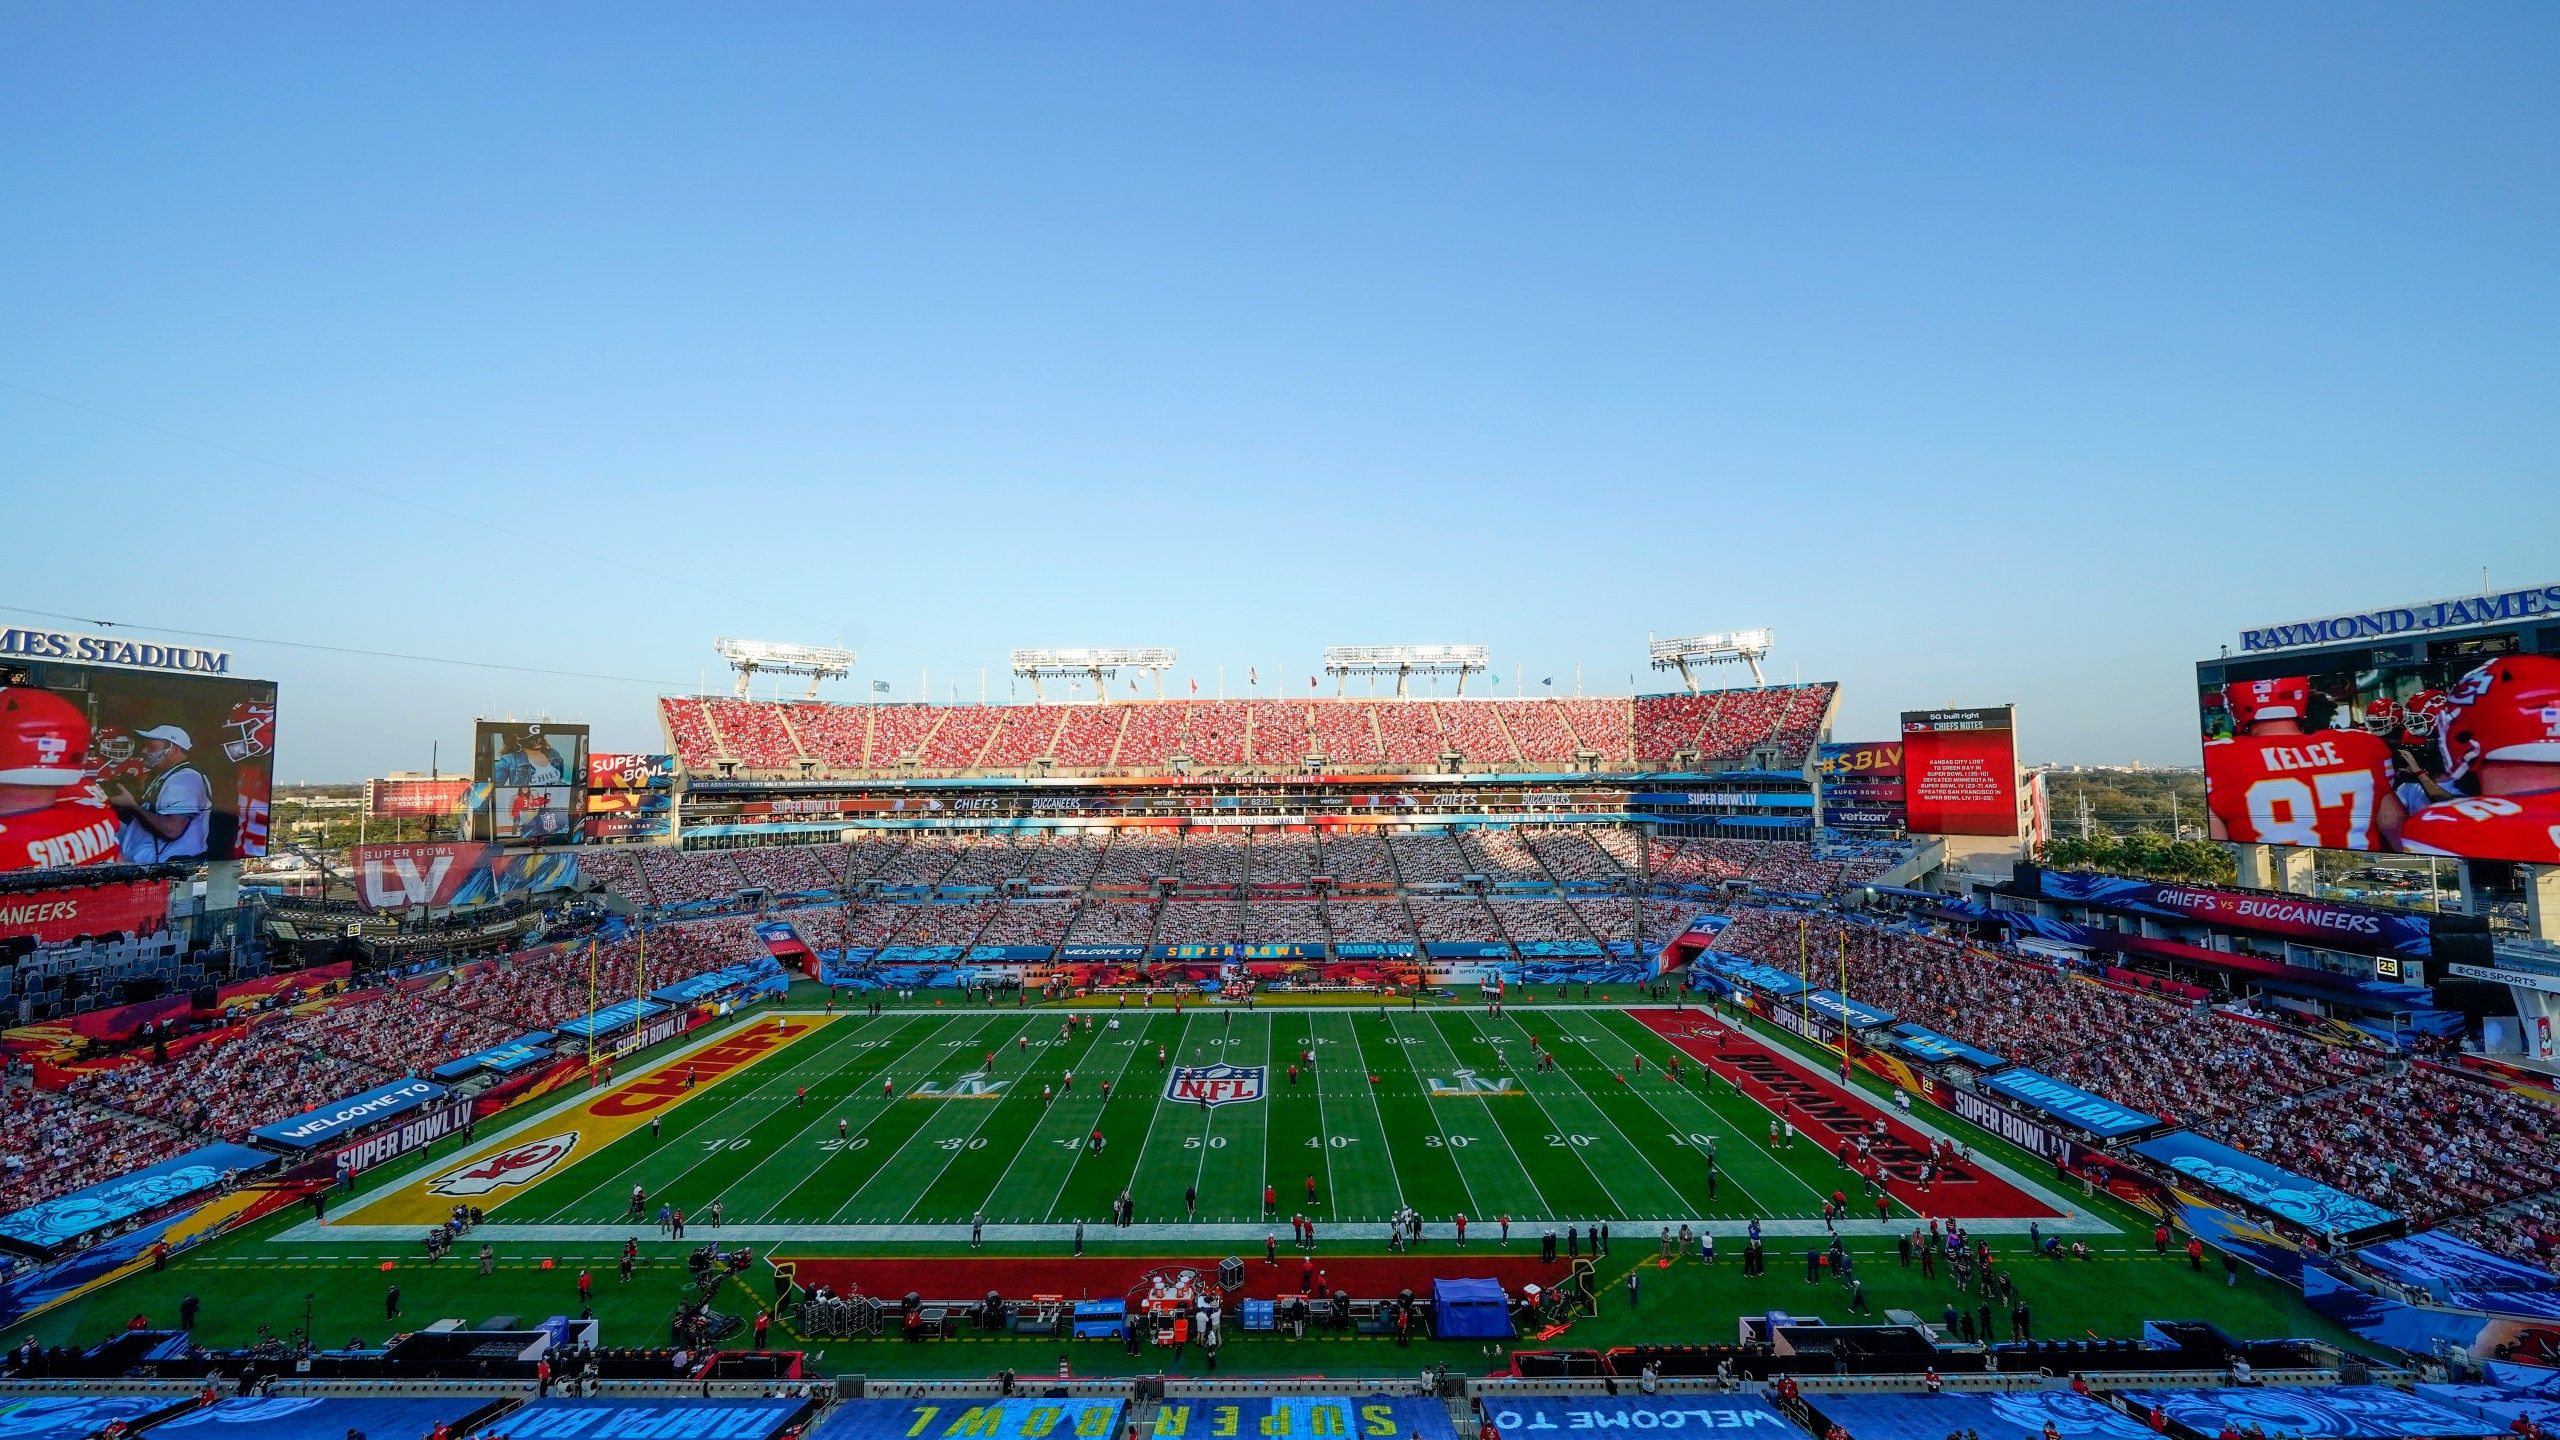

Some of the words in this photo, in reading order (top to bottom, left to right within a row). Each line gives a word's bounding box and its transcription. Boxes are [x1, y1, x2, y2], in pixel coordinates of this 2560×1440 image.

[2242, 607, 2415, 651] RAYMOND
[2422, 584, 2560, 629] JAMES
[77, 637, 229, 673] STADIUM
[1934, 721, 1959, 731] CHIEFS
[1960, 721, 1984, 730] NOTES
[1961, 712, 1980, 720] right
[529, 725, 541, 735] G
[593, 754, 647, 774] SUPER
[1822, 745, 1904, 773] #SBLV
[2260, 741, 2344, 772] KELCE
[623, 764, 672, 782] BOWL
[772, 801, 801, 813] SUPER
[830, 800, 840, 811] LV
[954, 799, 998, 810] CHIEFS
[1032, 798, 1080, 809] BUCCANEERS
[1433, 796, 1478, 806] CHIEFS
[1522, 794, 1570, 805] BUCCANEERS
[1688, 793, 1716, 806] SUPER
[1718, 793, 1745, 806] BOWL
[1746, 793, 1758, 806] LV
[2245, 768, 2375, 850] 87
[1838, 812, 1886, 822] verizon
[364, 849, 410, 860] SUPER
[416, 847, 454, 858] BOWL
[364, 855, 454, 908] LV
[2156, 889, 2216, 910] CHIEFS
[2220, 900, 2234, 910] VS
[2236, 900, 2380, 934] BUCCANEERS
[350, 924, 359, 934] 25
[1168, 946, 1233, 958] SUPER
[1246, 946, 1304, 957] BOWL
[1336, 945, 1386, 955] TAMPA
[1388, 944, 1416, 954] BAY
[2380, 960, 2395, 972] 25
[2466, 968, 2488, 978] CBS
[2490, 972, 2537, 987] SPORTS
[1773, 1006, 1798, 1033] SUPER
[1807, 994, 1857, 1016] WELCOME
[1855, 1010, 1879, 1024] TO
[566, 1006, 626, 1035] TAMPA
[616, 1029, 649, 1060] SUPER
[650, 1020, 674, 1043] BOWL
[675, 1014, 688, 1036] LV
[588, 1023, 810, 1117] CHIEFS
[1176, 1080, 1254, 1101] NFL
[1924, 1079, 1933, 1090] 25
[281, 1094, 400, 1138] WELCOME
[394, 1084, 430, 1098] TO
[1994, 1072, 2086, 1110] TAMPA
[2067, 1102, 2145, 1129] BAY
[1954, 1090, 2000, 1134] SUPER
[2002, 1112, 2048, 1157] BOWL
[336, 1130, 400, 1178] SUPER
[402, 1112, 450, 1151] BOWL
[454, 1100, 473, 1129] LV
[706, 1138, 752, 1152] 10
[822, 1138, 870, 1151] 20
[942, 1138, 988, 1151] 30
[1183, 1136, 1227, 1149] 50
[1304, 1136, 1350, 1148] 40
[1425, 1136, 1473, 1148] 30
[1544, 1134, 1590, 1148] 20
[1666, 1133, 1710, 1146] 10
[590, 1407, 788, 1439] TAMPA
[904, 1405, 1121, 1438] BOWL
[1154, 1404, 1398, 1437] SUPER
[1496, 1410, 1558, 1430] TO
[1566, 1409, 1786, 1430] WELCOME
